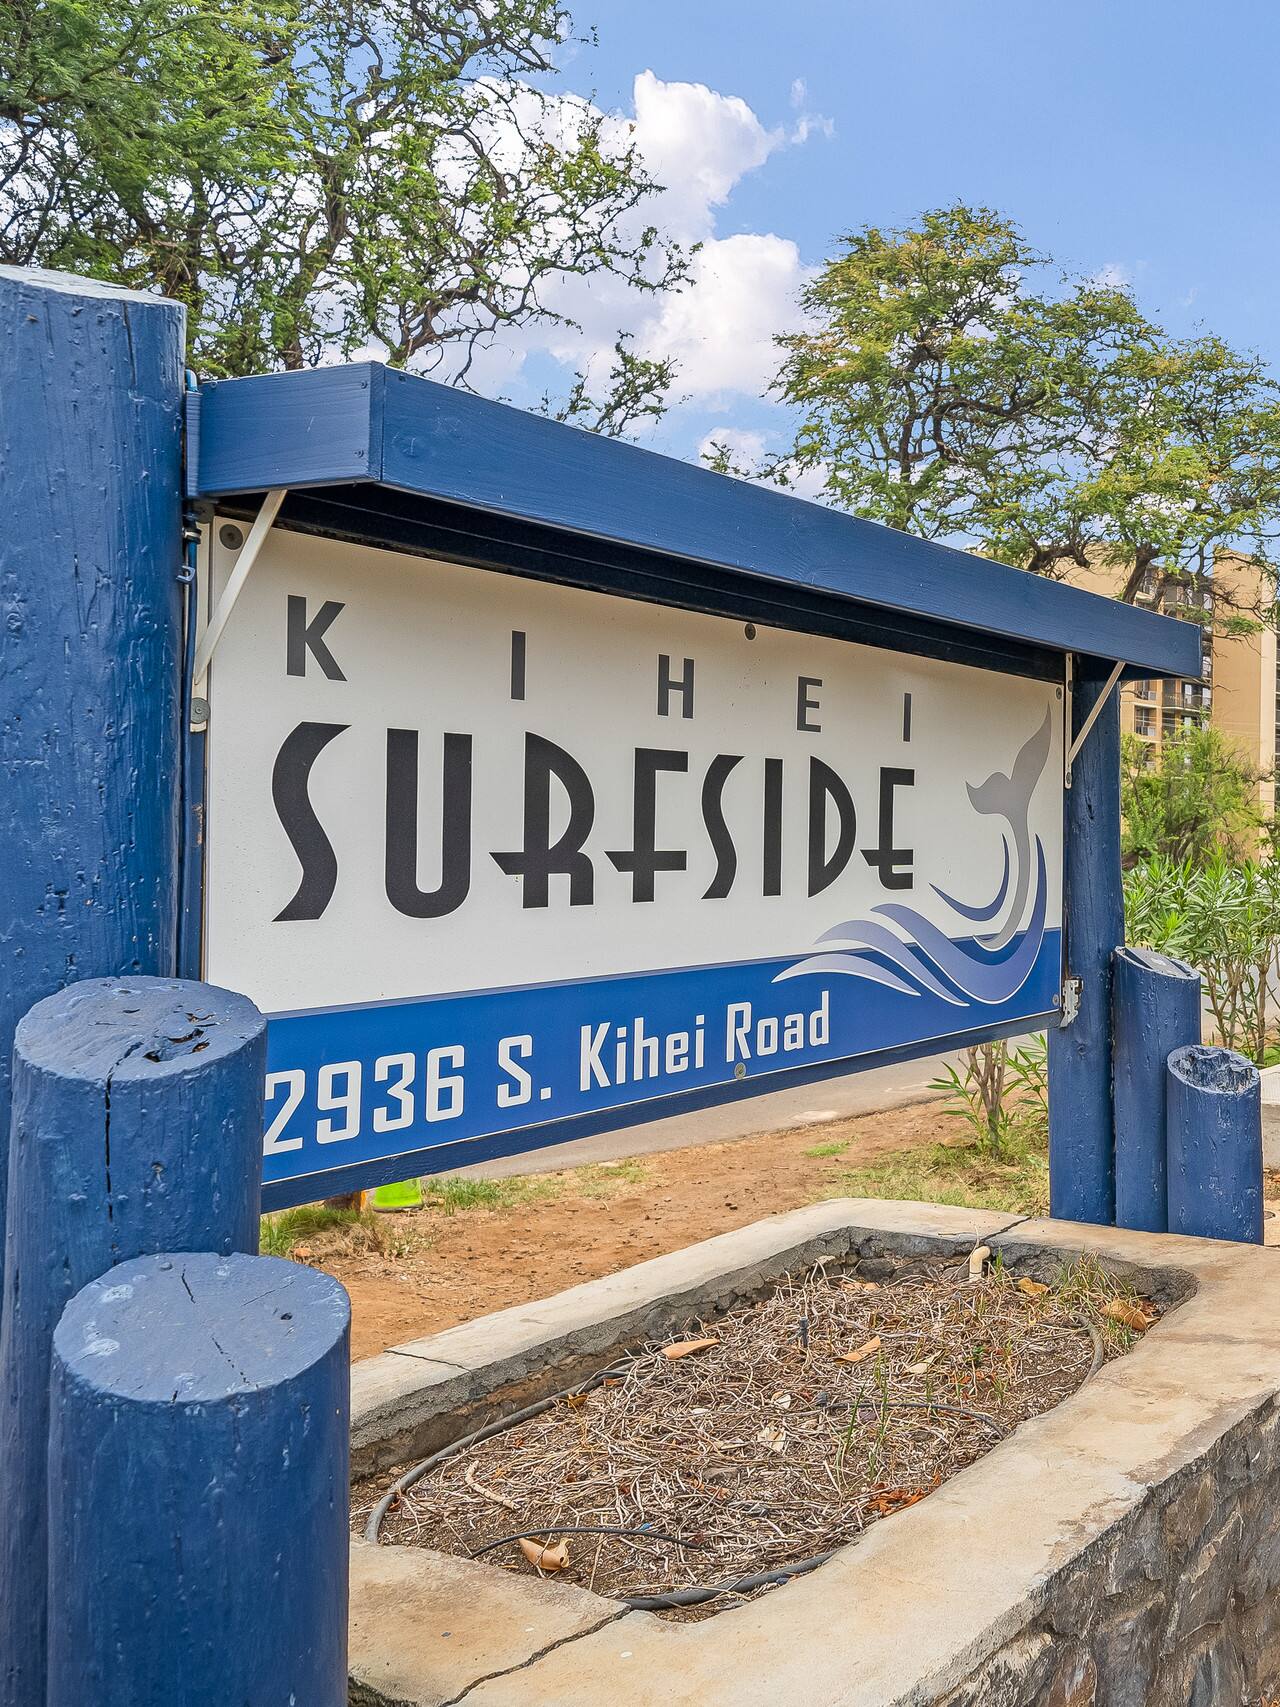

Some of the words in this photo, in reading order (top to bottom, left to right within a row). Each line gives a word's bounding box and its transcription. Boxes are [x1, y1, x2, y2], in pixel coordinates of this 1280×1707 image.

[287, 595, 912, 742] KIHEI
[272, 721, 915, 922] SURFSIDE
[263, 1045, 465, 1156] 2936
[497, 1034, 551, 1108] S.
[579, 1014, 704, 1092] Kihei
[726, 990, 830, 1063] Road
